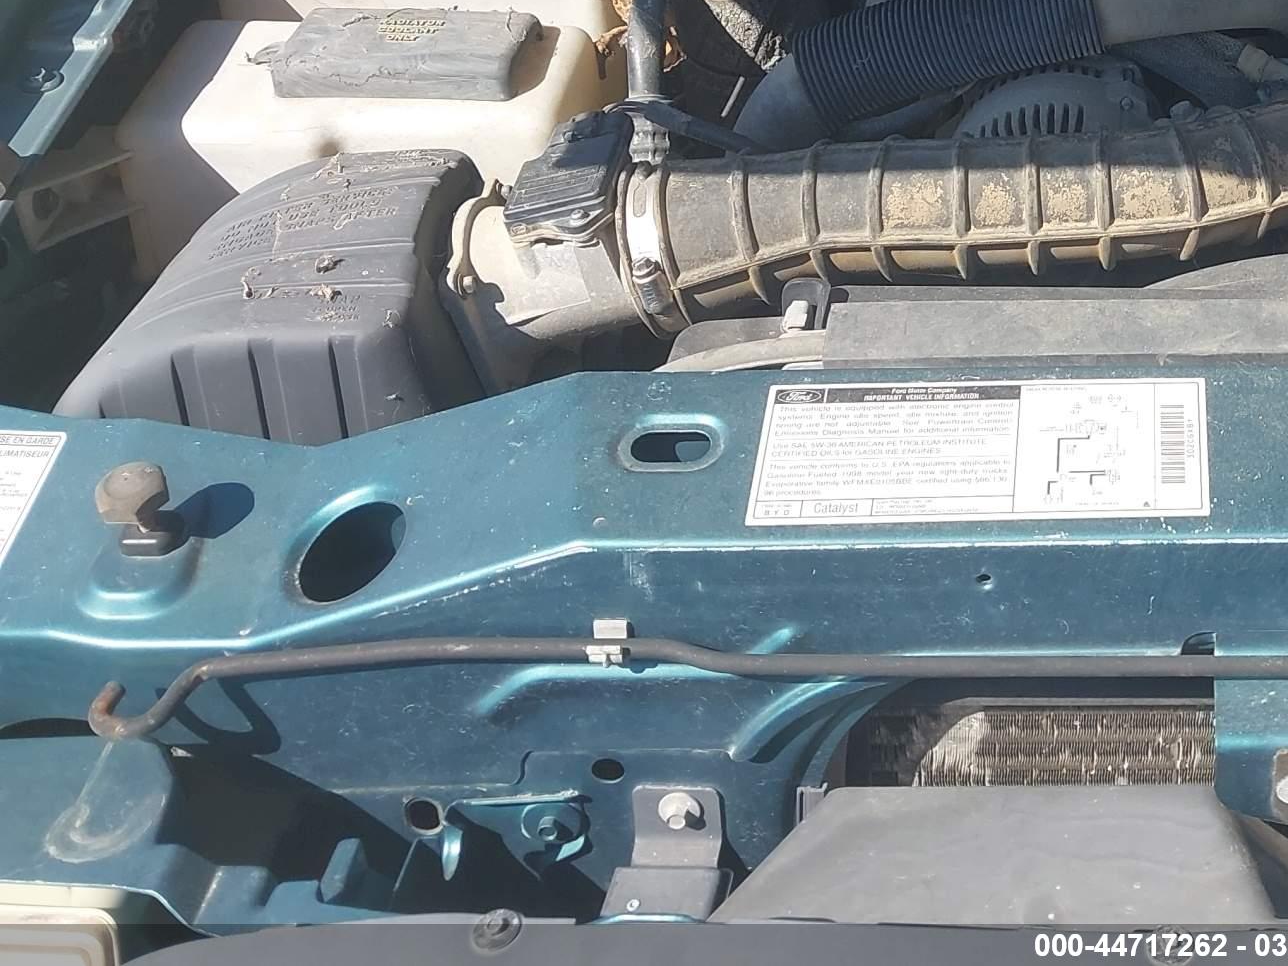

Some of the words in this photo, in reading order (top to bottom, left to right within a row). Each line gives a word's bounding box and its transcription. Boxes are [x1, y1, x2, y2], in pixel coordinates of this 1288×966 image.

[378, 26, 440, 34] COOLANT
[386, 34, 420, 42] ONLY
[863, 394, 903, 402] IMPORTANT
[905, 393, 932, 401] VEHICLE
[934, 392, 980, 400] INFORMATION
[13, 436, 24, 444] EN
[25, 437, 55, 445] GARDE
[814, 502, 858, 514] Catalyst
